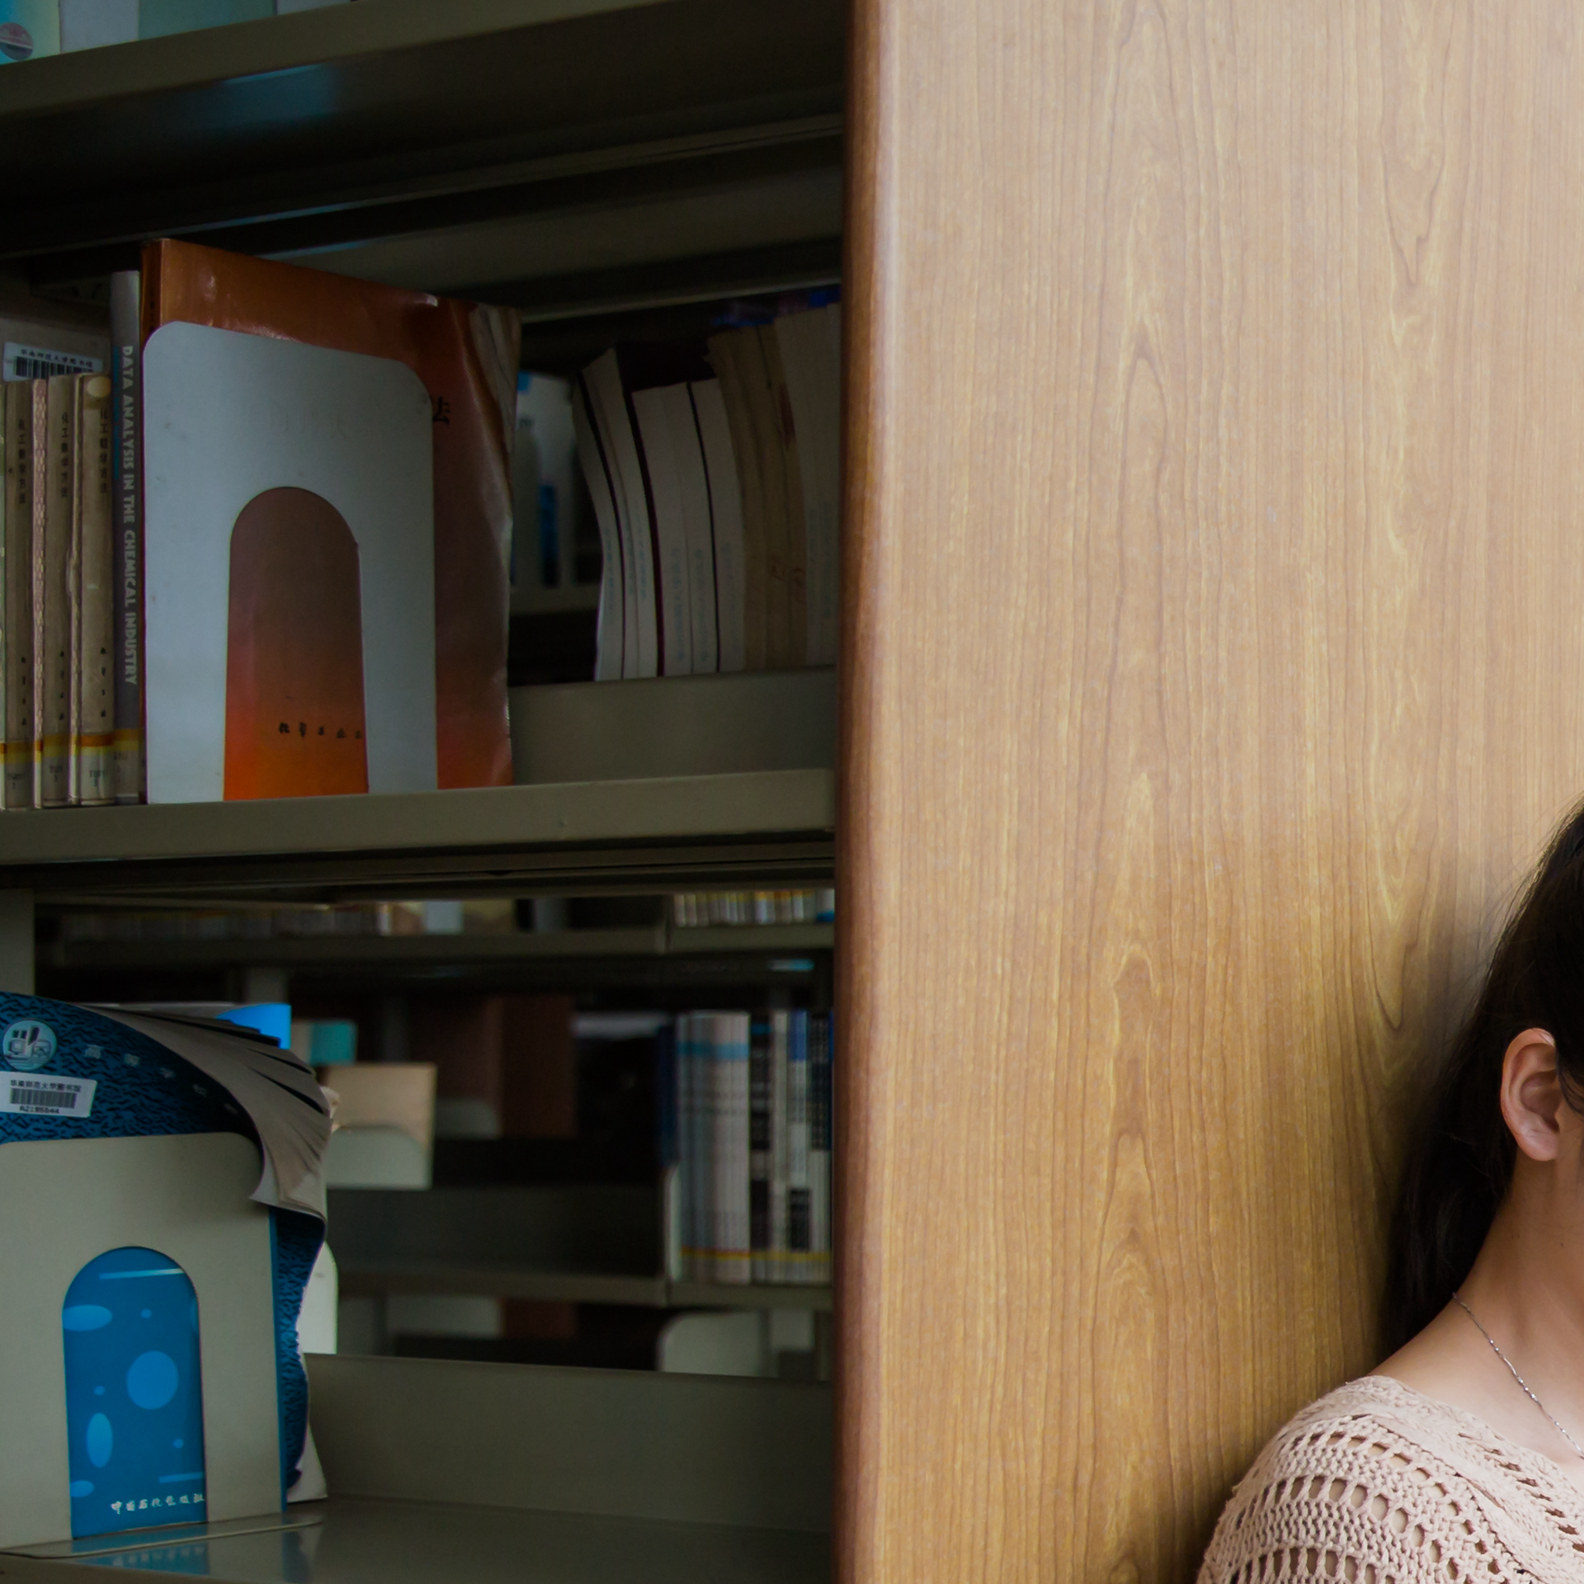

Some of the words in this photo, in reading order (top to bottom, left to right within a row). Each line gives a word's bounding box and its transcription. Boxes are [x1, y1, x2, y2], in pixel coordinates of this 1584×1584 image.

[122, 345, 134, 390] DATA
[122, 395, 135, 469] ANALYSIS
[123, 474, 135, 490] IN
[123, 495, 136, 524] THE
[124, 530, 136, 607] CHEMICAL
[125, 613, 137, 685] INDUSTRY
